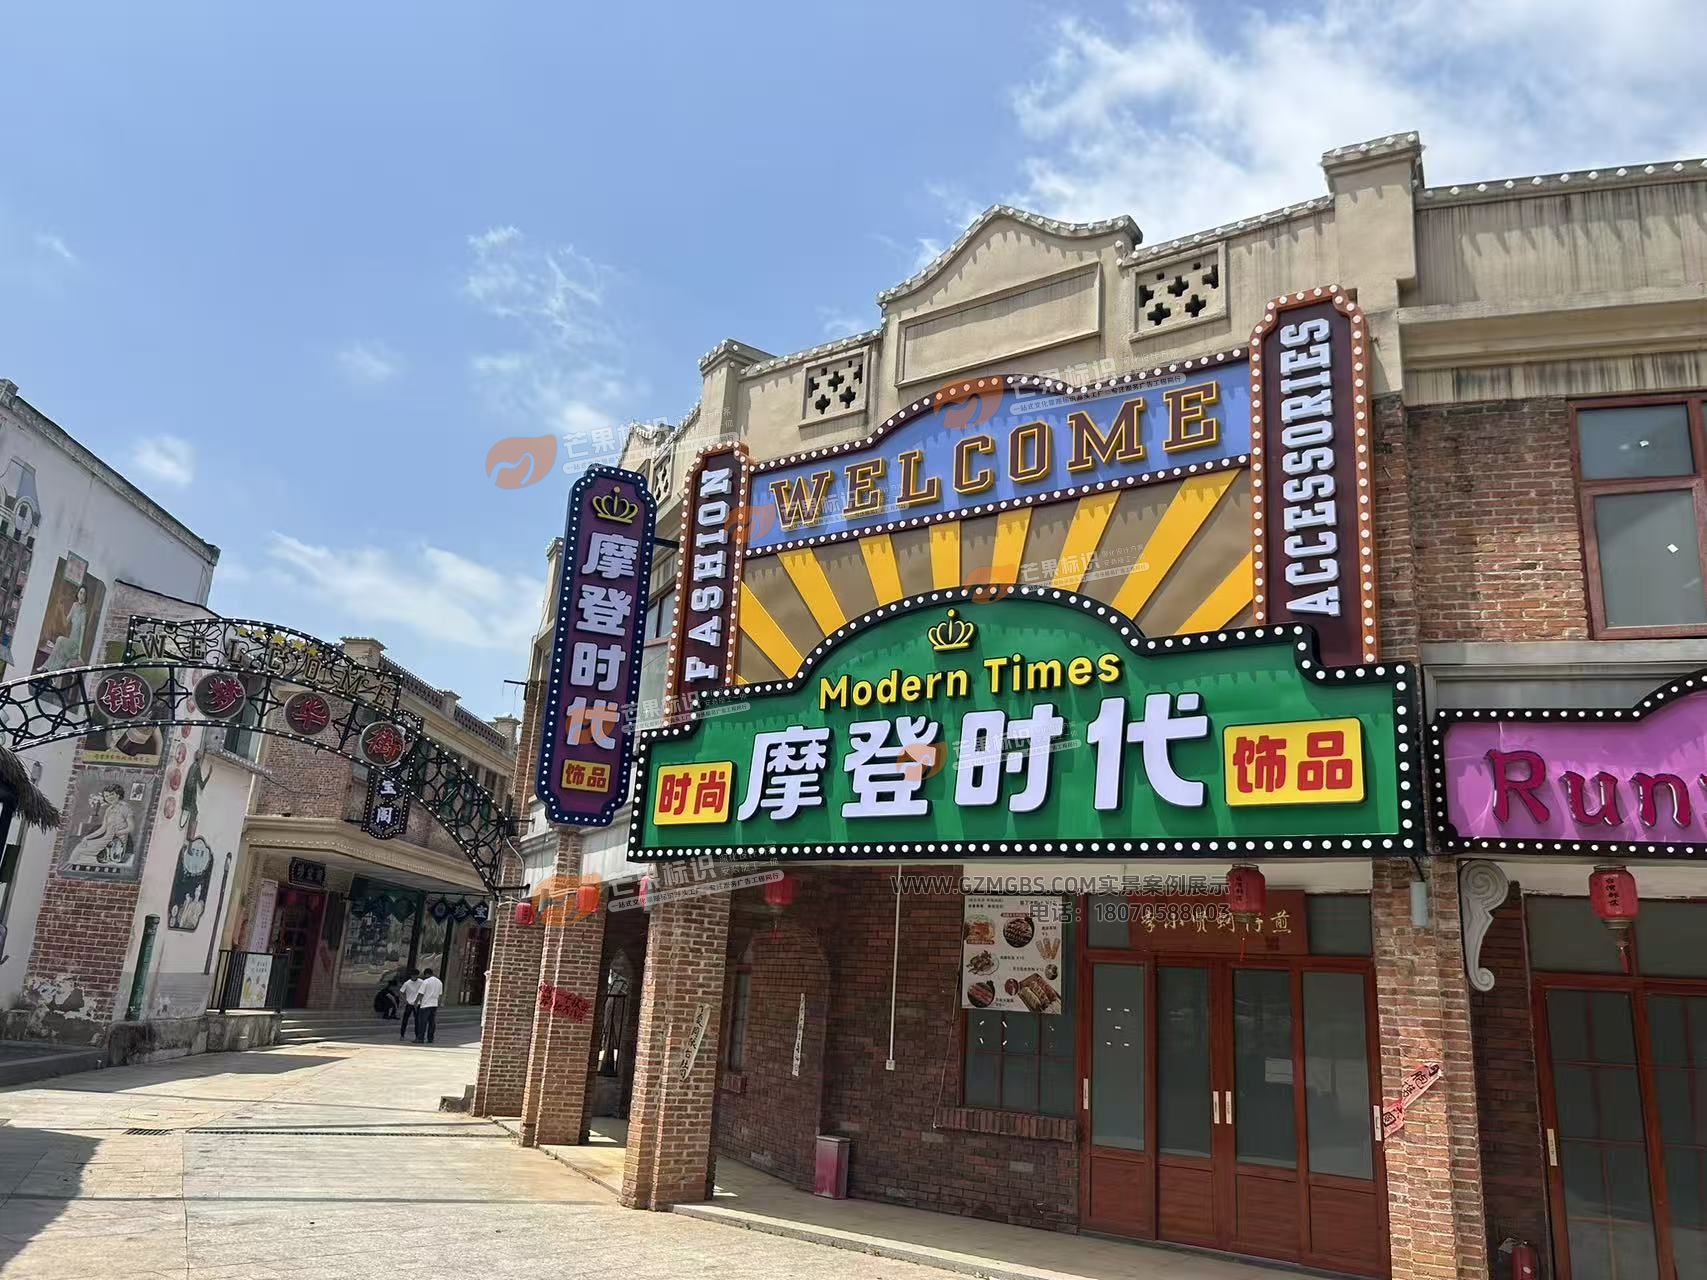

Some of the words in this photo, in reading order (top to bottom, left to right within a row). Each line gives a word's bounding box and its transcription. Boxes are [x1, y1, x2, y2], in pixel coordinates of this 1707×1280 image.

[769, 380, 1220, 529] WELCOME
[1279, 317, 1340, 618] ACCESSORIES
[566, 531, 640, 750] 摩登时代
[684, 467, 732, 684] FASHION
[140, 634, 394, 713] WELCOME
[818, 669, 969, 711] Modern
[984, 651, 1122, 694] Times
[565, 762, 609, 789] 饰品
[658, 770, 727, 815] 时尚
[737, 692, 1209, 822] 摩登时代
[1233, 730, 1353, 791] 饰品
[1483, 748, 1707, 828] Run
